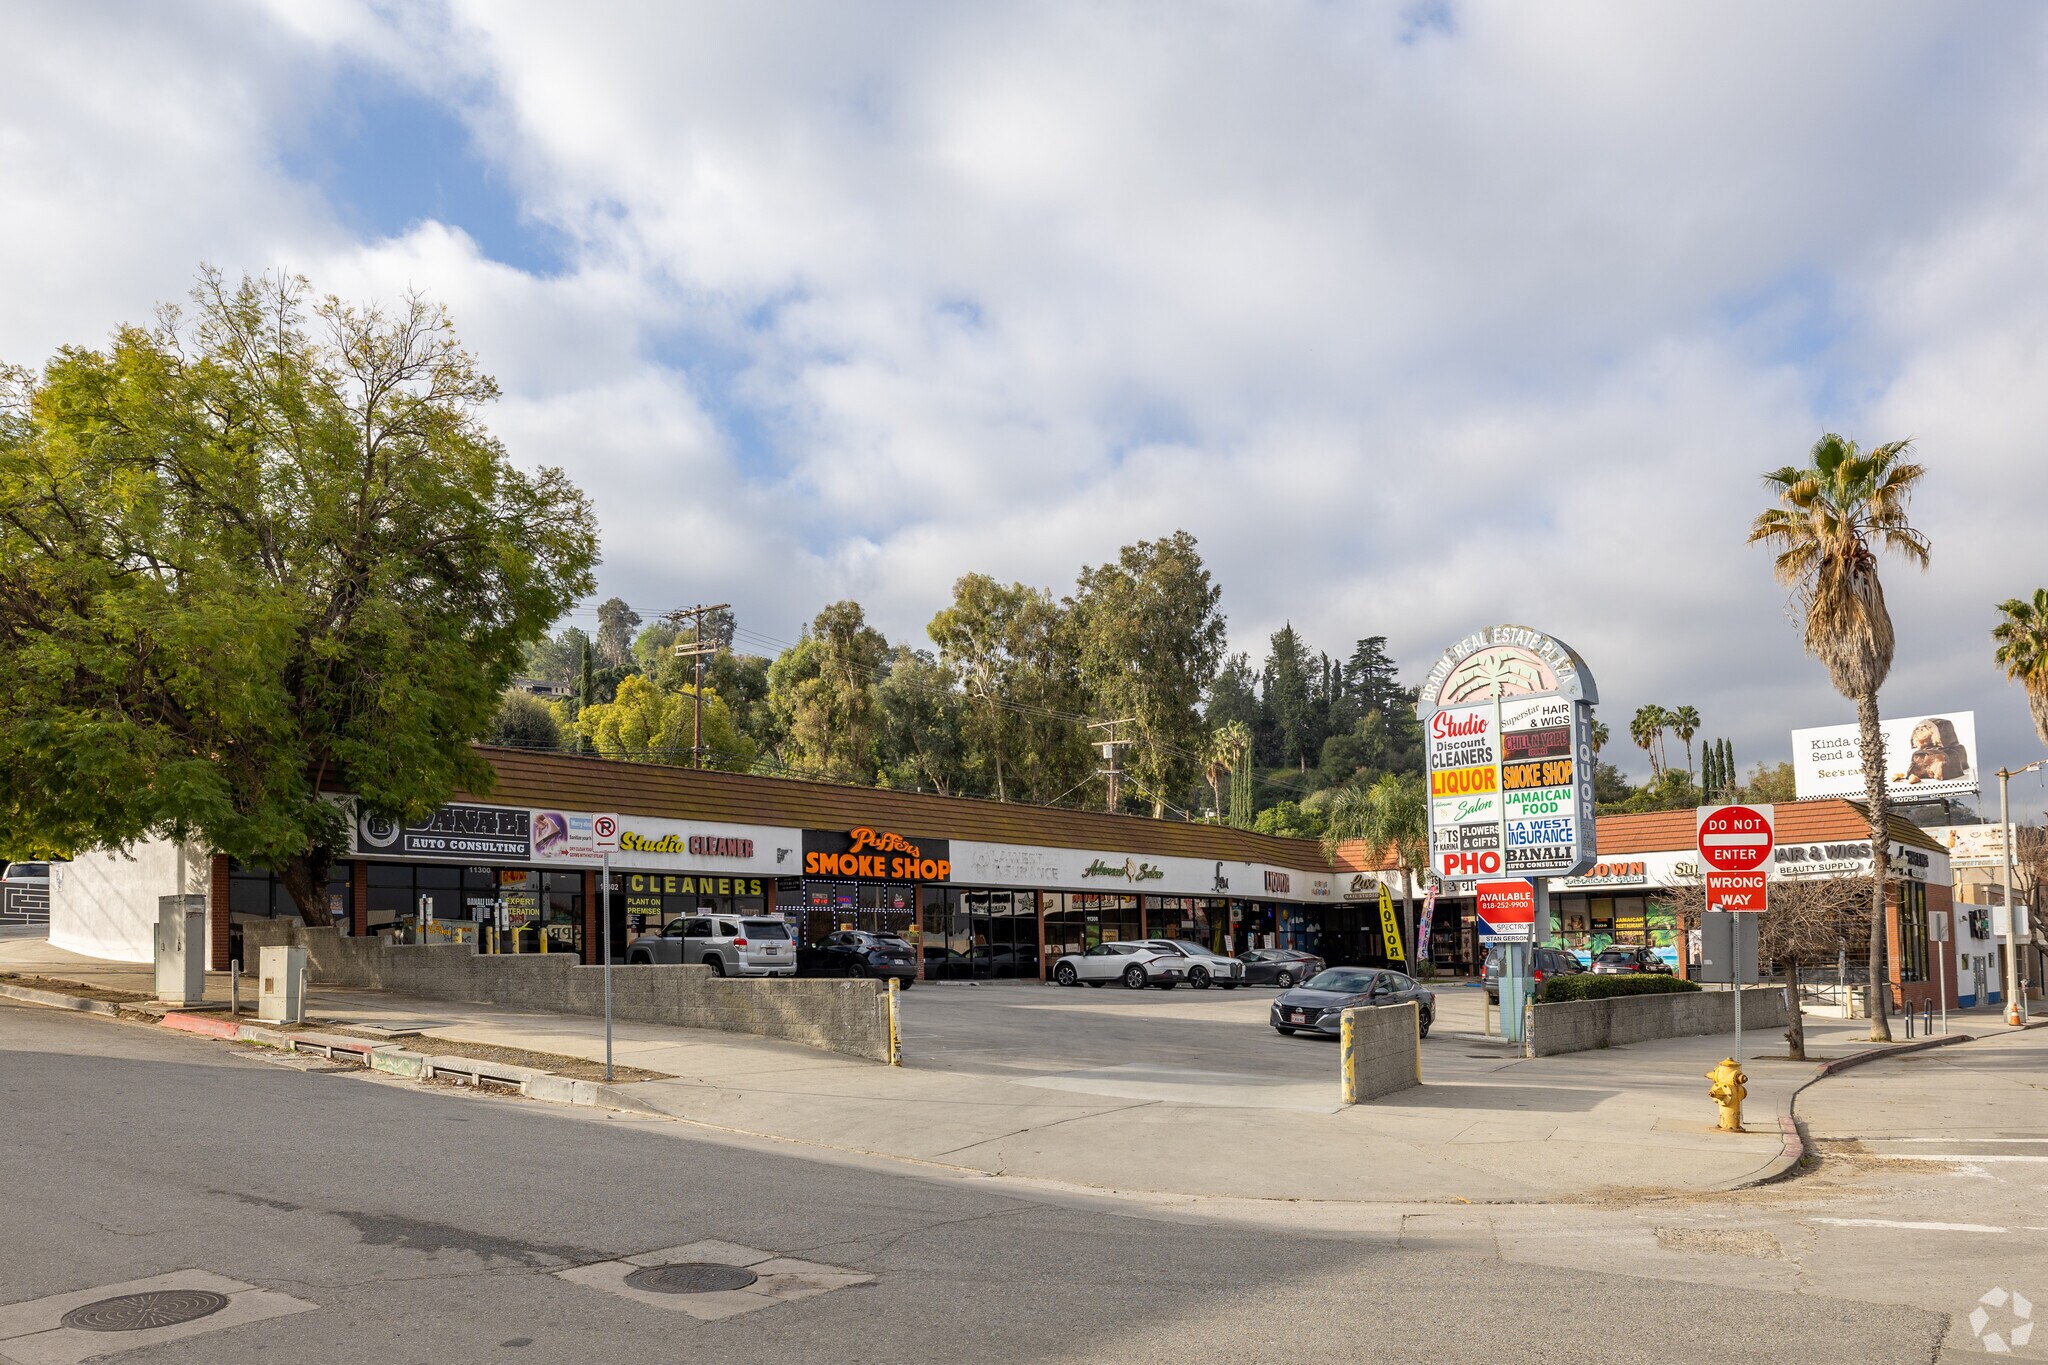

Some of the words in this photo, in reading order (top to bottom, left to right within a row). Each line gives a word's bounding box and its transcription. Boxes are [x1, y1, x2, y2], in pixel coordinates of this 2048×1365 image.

[1421, 655, 1455, 702] BRAUM
[1453, 631, 1488, 659] REAL
[1493, 627, 1542, 649] ESTATE
[1539, 641, 1577, 685] PLAZA
[1501, 704, 1540, 728] Superstar
[1542, 703, 1569, 715] HAIR
[1530, 718, 1537, 728] &
[1540, 715, 1570, 727] WIGS
[1433, 711, 1490, 739] Studio
[1436, 737, 1486, 752] Discount
[1505, 736, 1529, 751] CHILL
[1540, 730, 1567, 747] VAPE
[1811, 737, 1851, 750] Kinda
[1431, 747, 1493, 769] CLEANERS
[1578, 704, 1594, 820] LIQUOR
[1812, 752, 1843, 762] Send
[1846, 750, 1855, 758] a
[1432, 768, 1496, 795] LIQUOR
[1503, 763, 1541, 790] SMOKE
[1542, 760, 1573, 786] SHOP
[1818, 769, 1846, 779] See's
[1505, 788, 1571, 805] JAMAICAN
[1893, 795, 1919, 803] 001758
[1454, 797, 1493, 822] Salon
[1522, 801, 1559, 815] FOOD
[1461, 825, 1500, 837] FLOWERS
[1507, 822, 1525, 831] LA
[1529, 818, 1571, 830] WEST
[1709, 820, 1727, 831] DO
[1734, 819, 1761, 830] NOT
[620, 831, 685, 853] Studio
[689, 835, 754, 858] CLEANER
[850, 826, 920, 858] Puffers
[1463, 839, 1470, 848] &
[1472, 836, 1498, 847] GIFTS
[1508, 828, 1573, 846] INSURANCE
[412, 838, 446, 849] AUTO
[449, 840, 525, 853] CONSULTING
[1440, 843, 1459, 851] KARINA
[1808, 846, 1822, 861] &
[1824, 843, 1872, 859] WIGS
[1506, 846, 1572, 861] BANALI
[1715, 849, 1757, 860] ENTER
[805, 851, 886, 877] SMOKE
[891, 857, 951, 880] SHOP
[1443, 851, 1501, 876] PHO
[1506, 862, 1525, 870] AUTO
[1526, 860, 1572, 869] CONSULTING
[1780, 865, 1816, 874] BEAUTY
[1818, 862, 1855, 871] SUPPLY
[631, 875, 762, 896] CLEANERS
[1264, 870, 1290, 893] LIQUOR
[1350, 874, 1376, 893] Lux
[1565, 877, 1613, 885] JAMAICAN
[1615, 876, 1643, 884] GRILL
[1709, 877, 1764, 889] WRONG
[1480, 892, 1531, 902] AVAILABLE
[1721, 894, 1752, 906] WAY
[508, 908, 540, 916] TERATION
